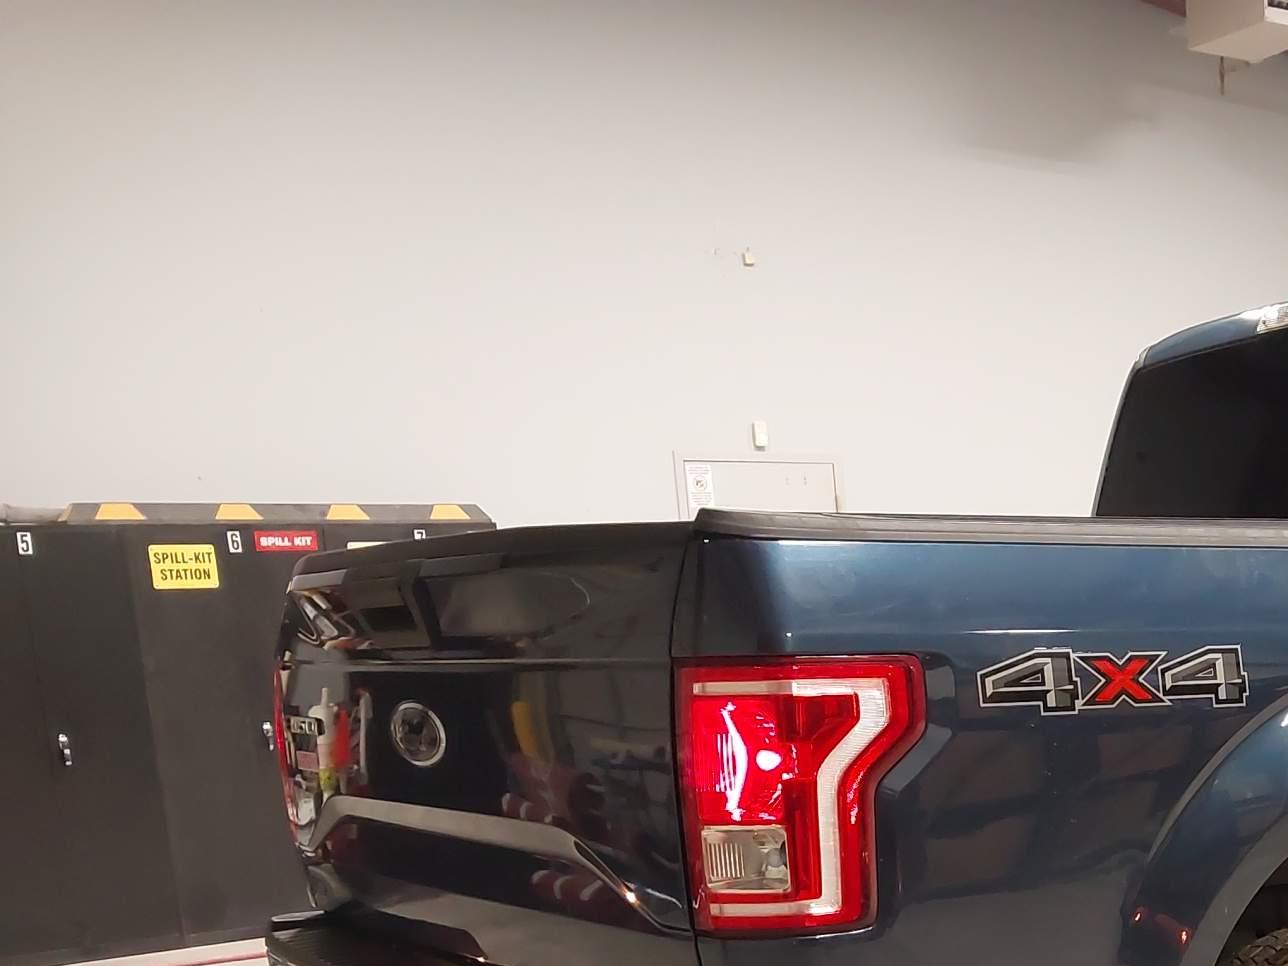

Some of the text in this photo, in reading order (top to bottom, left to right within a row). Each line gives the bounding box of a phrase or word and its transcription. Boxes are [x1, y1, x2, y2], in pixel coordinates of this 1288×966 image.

[20, 533, 30, 553] 5
[229, 533, 240, 551] 6
[259, 536, 313, 547] SPILL KIT
[153, 551, 214, 565] SPILL-KIT
[160, 567, 212, 582] STATION
